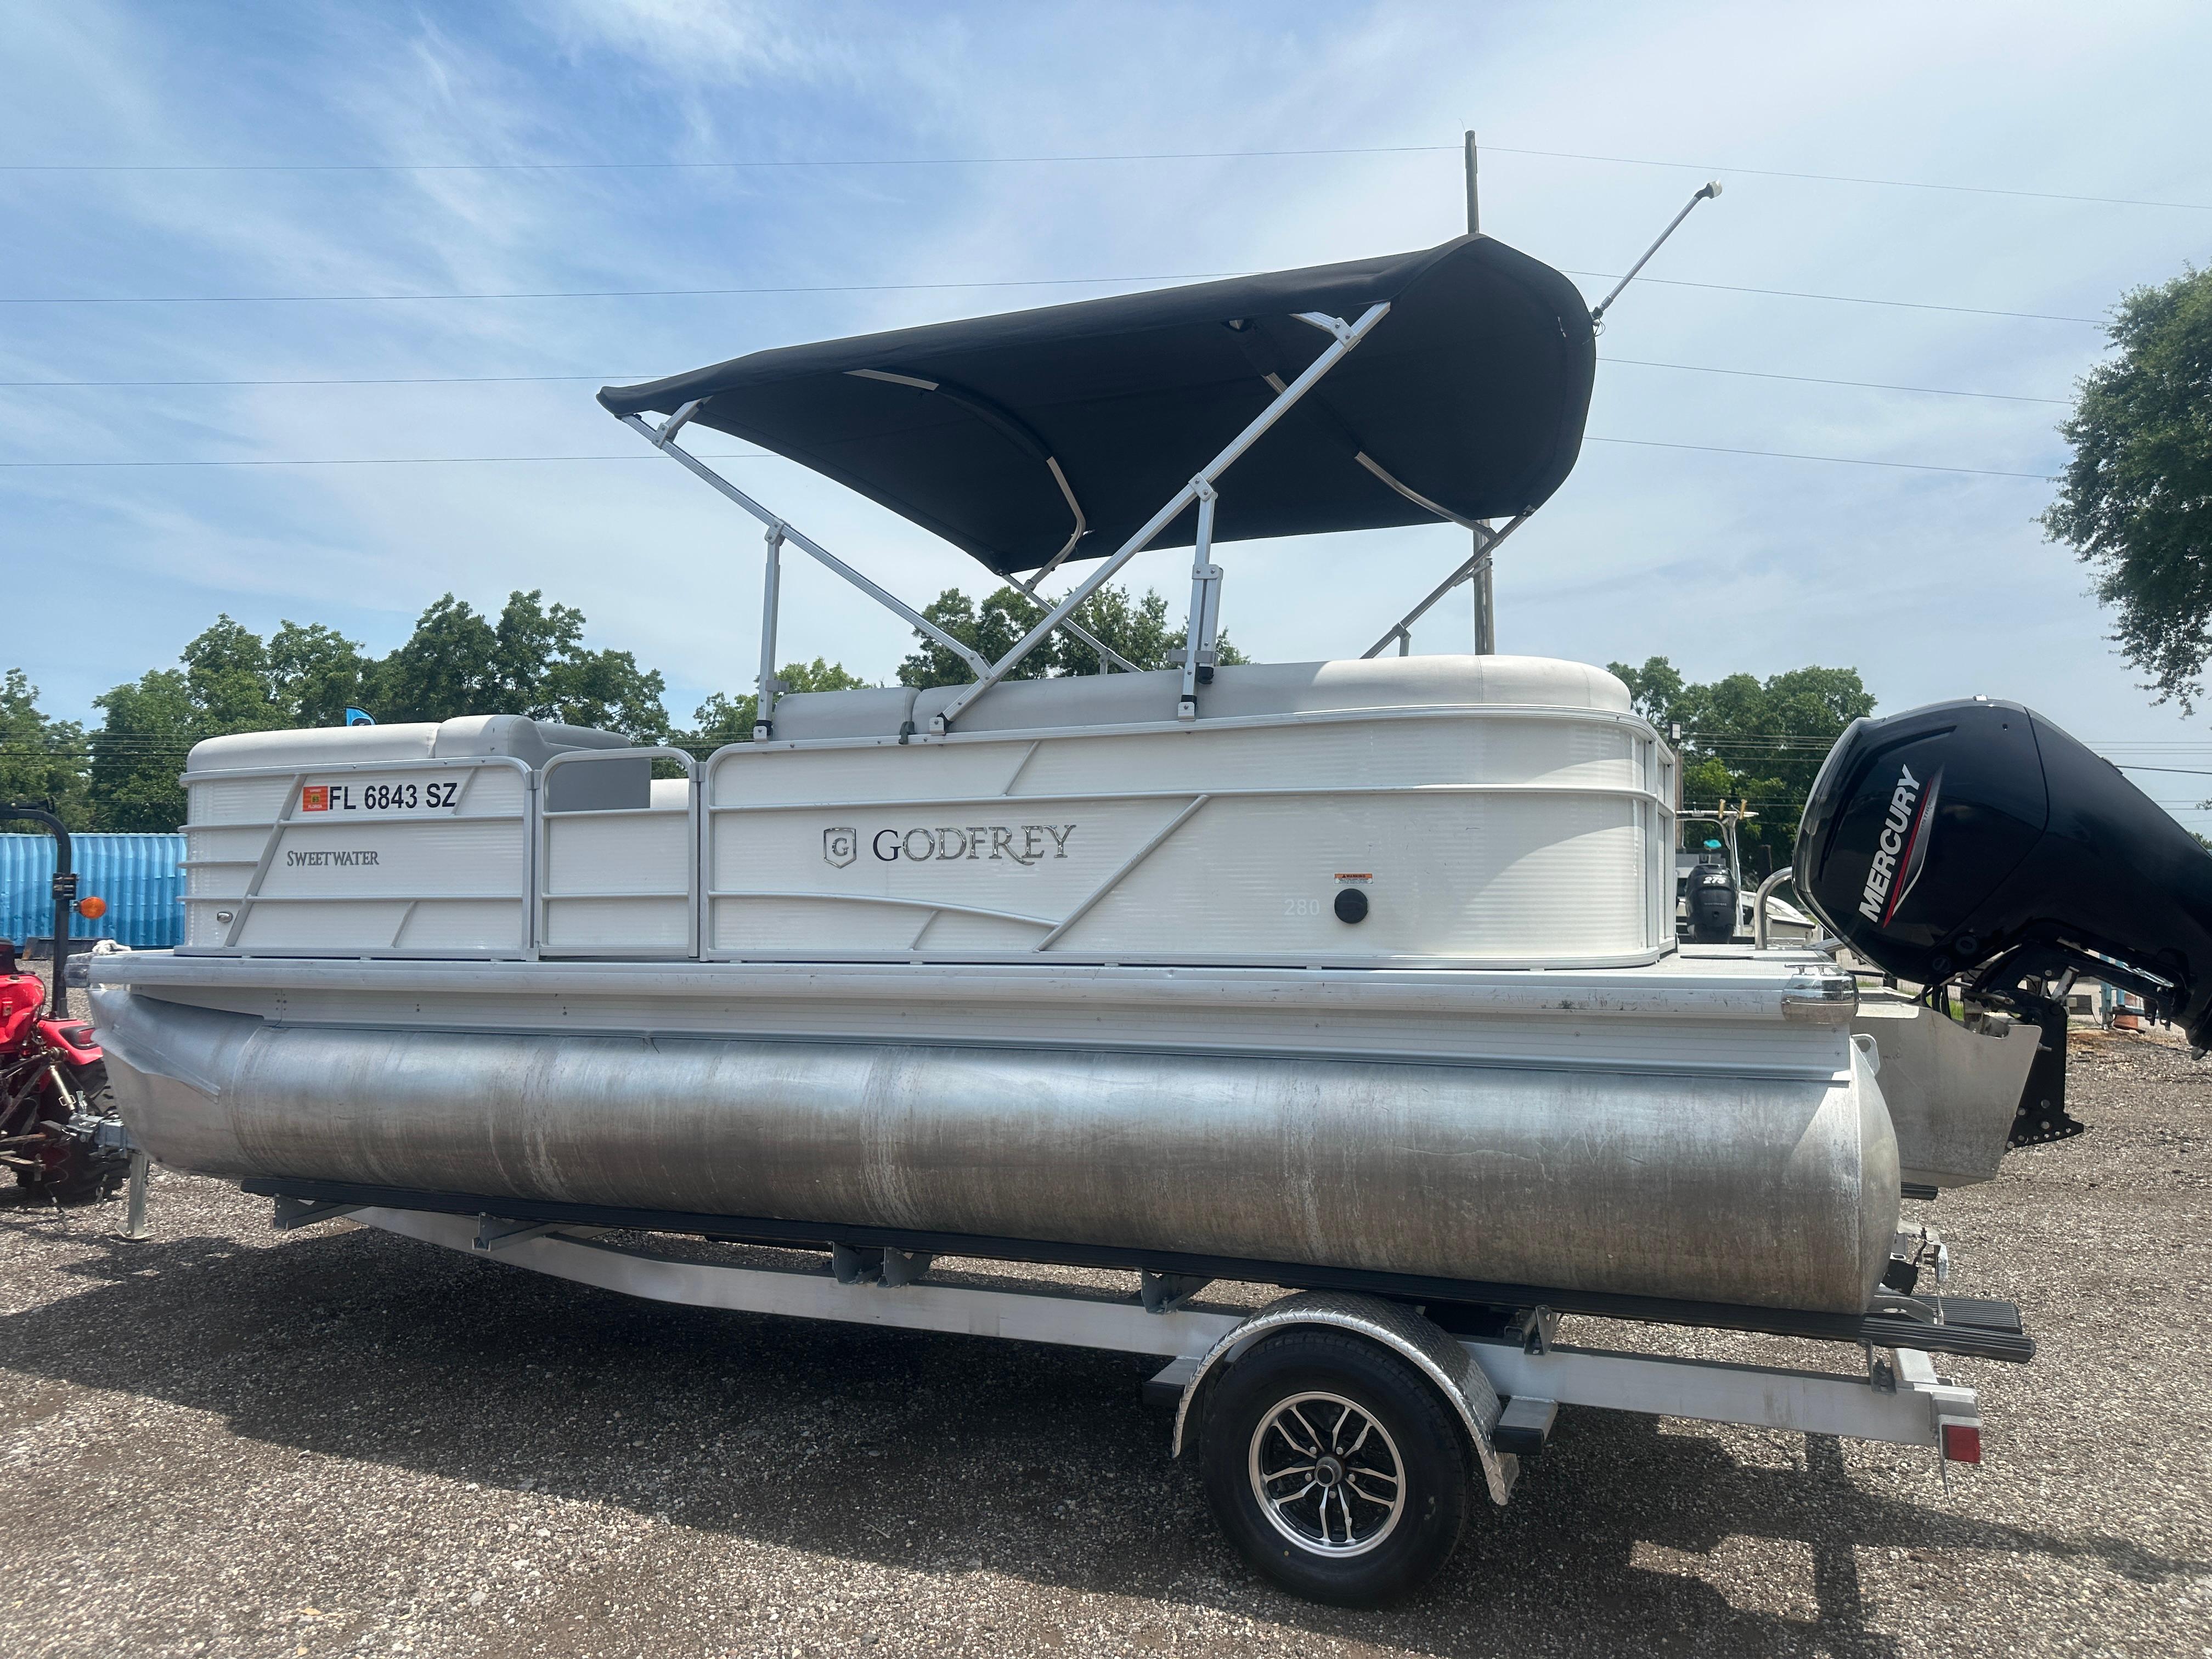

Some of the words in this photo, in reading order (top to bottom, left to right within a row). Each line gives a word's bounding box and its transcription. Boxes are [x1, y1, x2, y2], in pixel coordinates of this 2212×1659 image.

[329, 786, 356, 810] FL
[364, 784, 417, 809] 6843
[426, 782, 458, 808] SZ
[832, 838, 849, 857] G
[873, 824, 1077, 866] GODFREY
[1859, 764, 1920, 923] MERCURY
[287, 850, 379, 867] SWEETWATER
[1703, 876, 1726, 884] 275
[1284, 899, 1320, 916] 280
